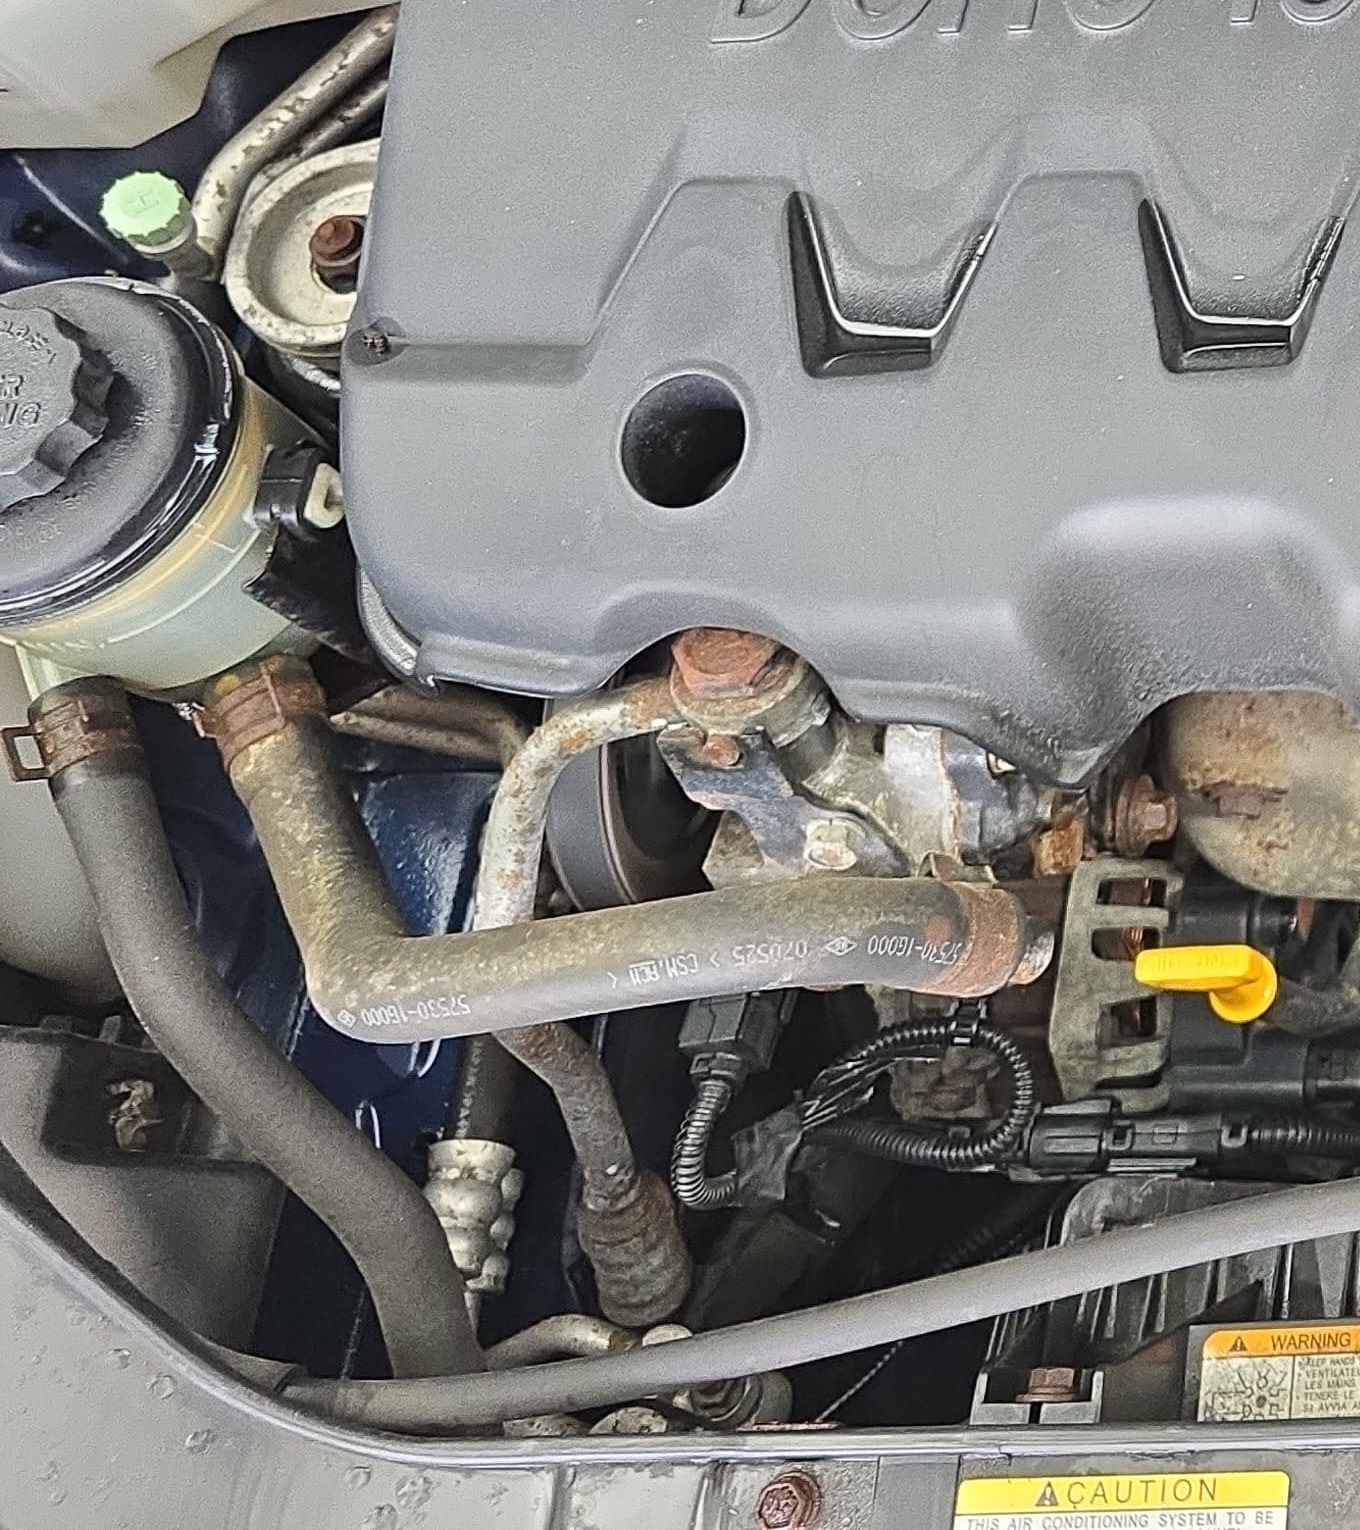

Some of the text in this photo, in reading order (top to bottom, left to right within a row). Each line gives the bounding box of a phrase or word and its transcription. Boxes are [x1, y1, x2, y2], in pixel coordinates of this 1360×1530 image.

[1271, 1332, 1351, 1350] WARNING
[1305, 1378, 1355, 1389] LES MAINS
[1067, 1478, 1216, 1504] CAUTION
[968, 1518, 998, 1530] THIS
[1009, 1517, 1032, 1530] AIR
[1042, 1515, 1148, 1529] CONDITIONING
[1158, 1513, 1216, 1526] SYSTEM
[1228, 1512, 1245, 1524] TO
[1255, 1511, 1272, 1524] BE
